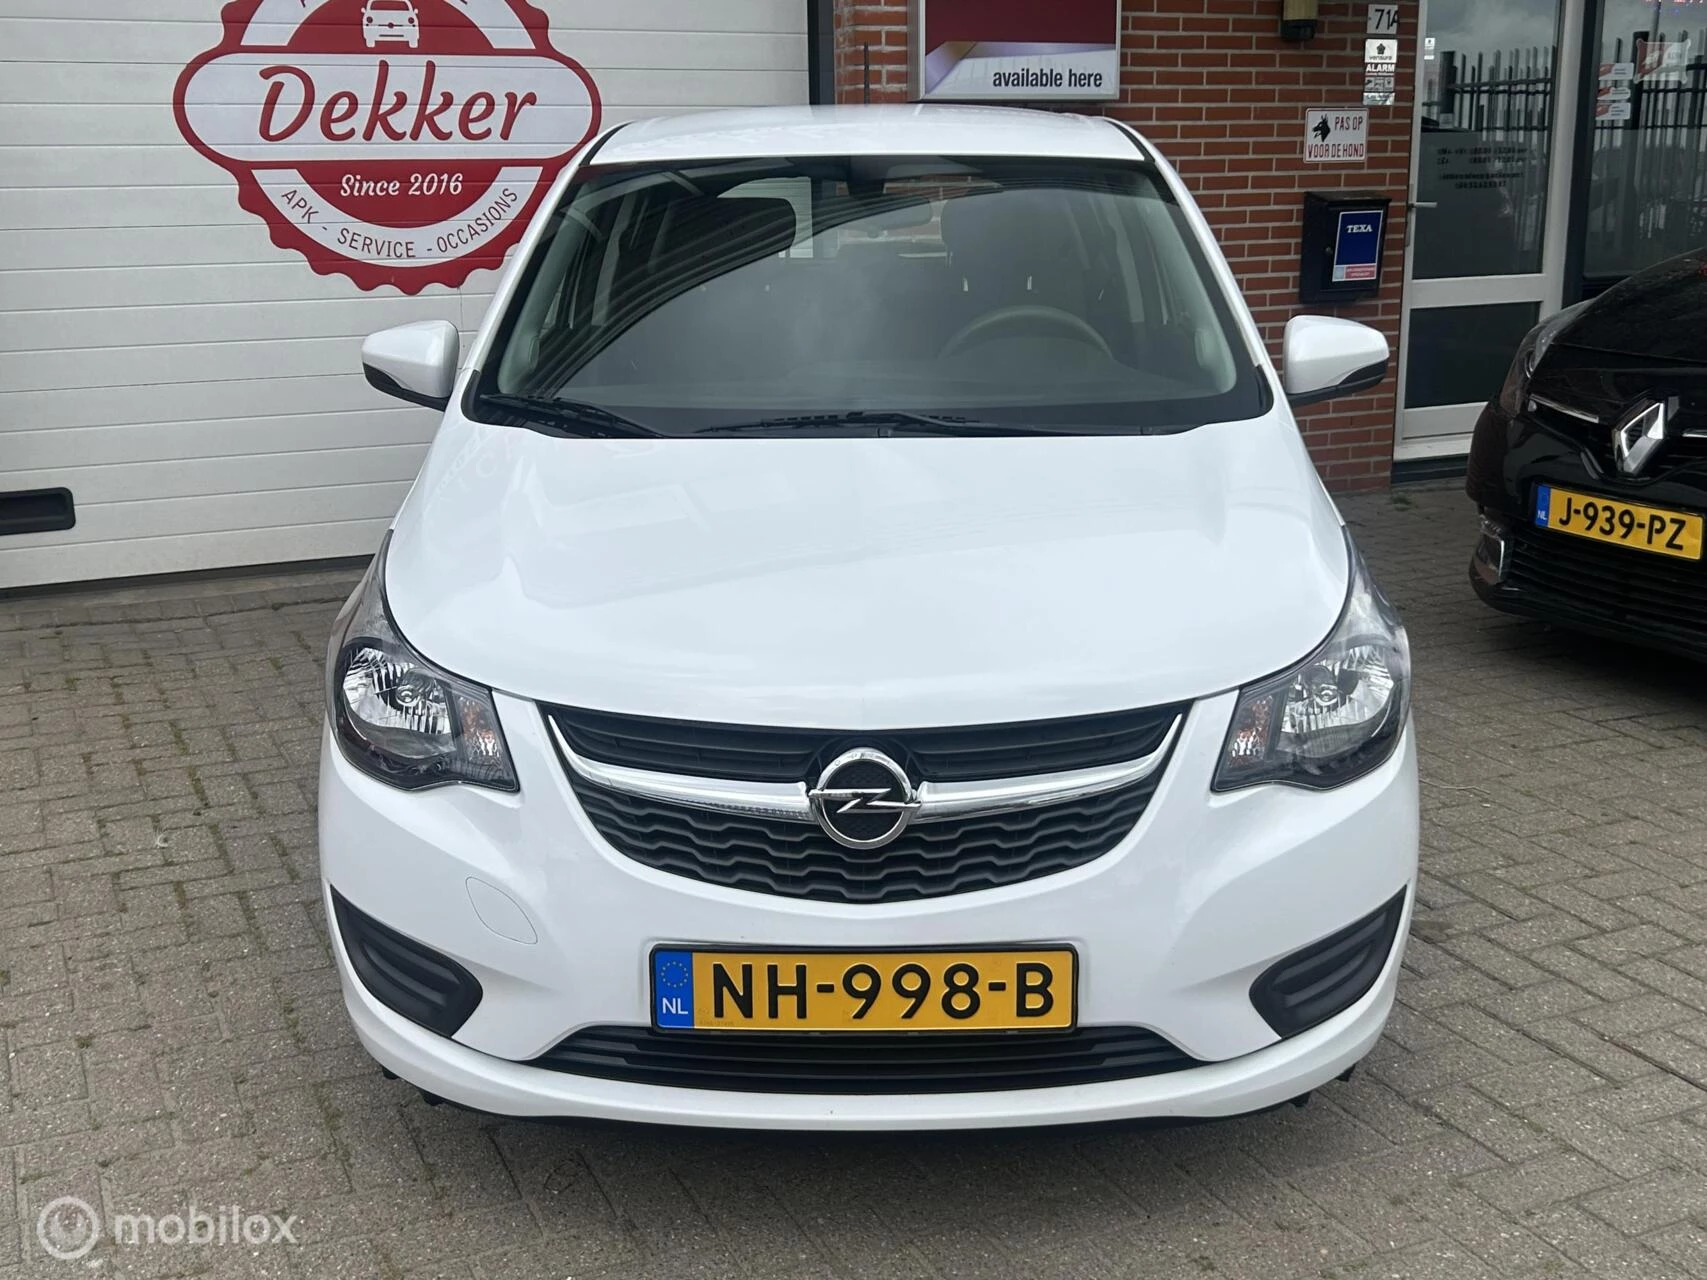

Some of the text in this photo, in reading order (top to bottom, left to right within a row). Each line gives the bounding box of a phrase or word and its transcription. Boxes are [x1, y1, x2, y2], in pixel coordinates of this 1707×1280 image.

[1366, 64, 1396, 73] ALARM
[993, 68, 1102, 88] available here
[258, 59, 538, 142] Dekker
[1335, 116, 1363, 130] PAS OP
[1308, 144, 1364, 158] VOOR DE HOND
[340, 172, 463, 197] Since 2016
[281, 189, 319, 225] APK
[337, 227, 417, 258] SERVICE
[436, 187, 518, 253] OCCASIONS
[1346, 224, 1373, 233] TEXA
[1537, 510, 1547, 521] NL
[1559, 497, 1687, 551] J-939-PZ
[713, 962, 1055, 1020] NH-998-B
[662, 998, 689, 1015] NL
